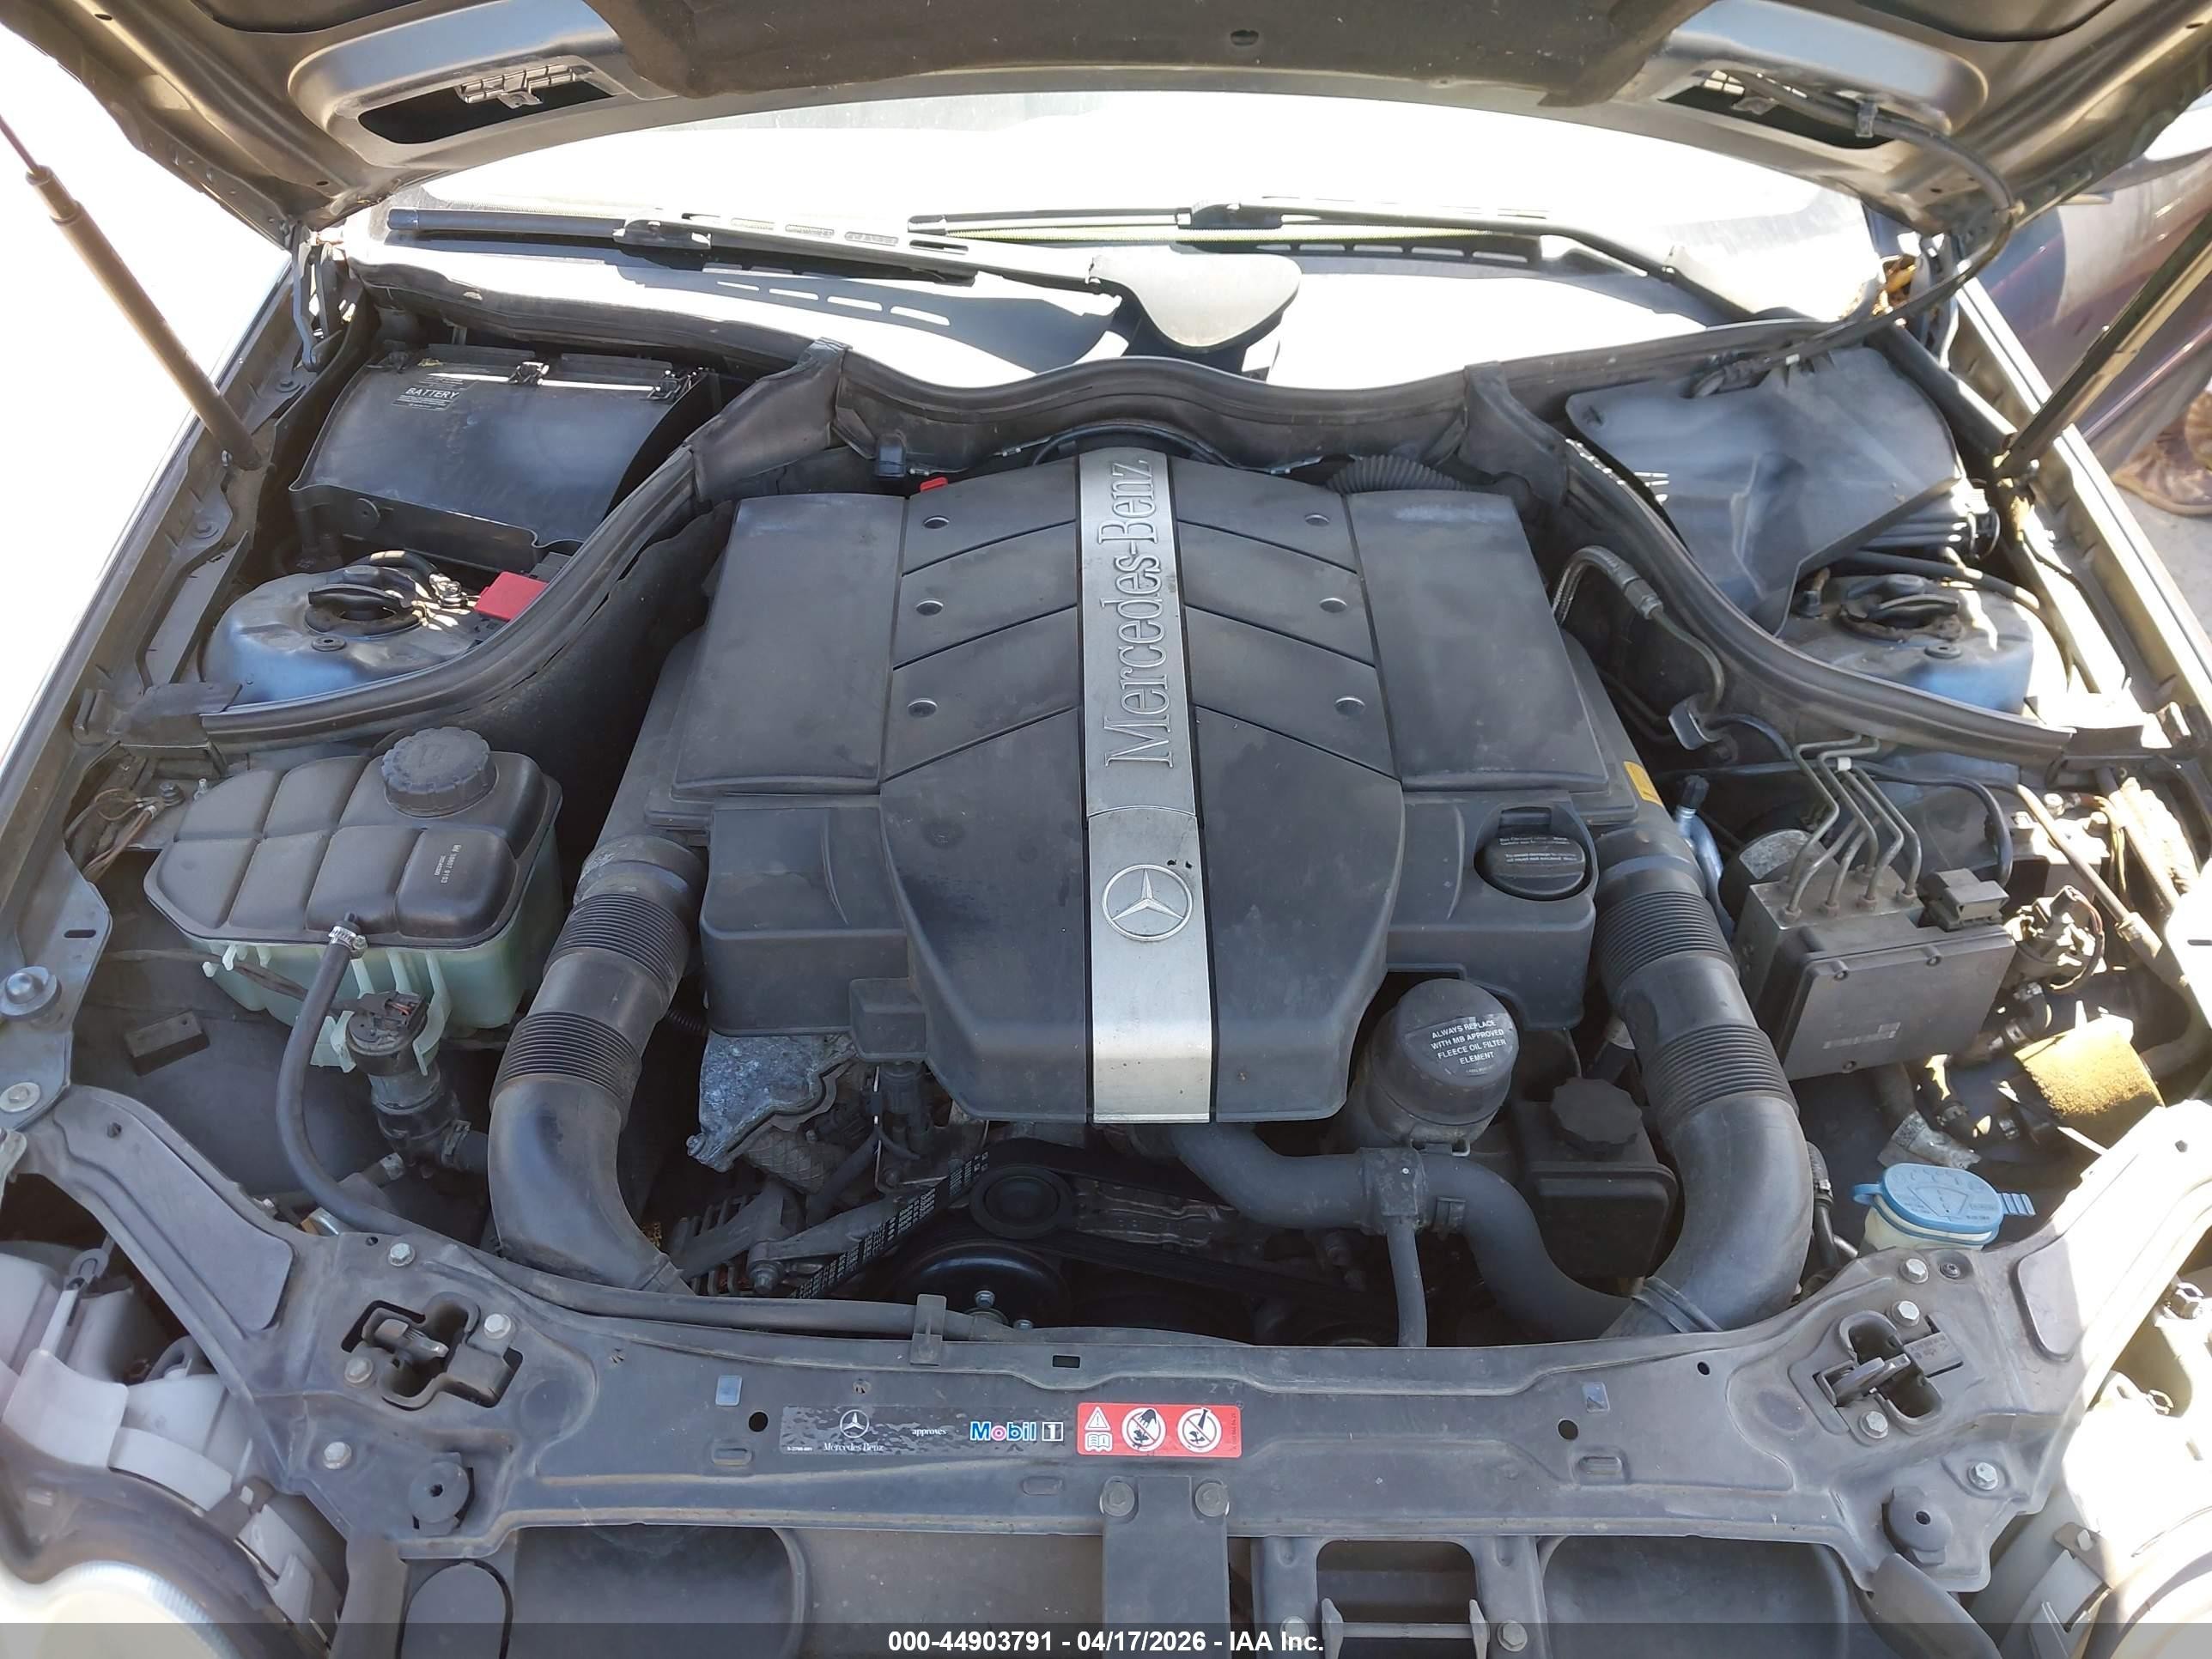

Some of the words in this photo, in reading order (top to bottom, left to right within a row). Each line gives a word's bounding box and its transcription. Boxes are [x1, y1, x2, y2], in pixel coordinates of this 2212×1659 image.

[405, 387, 460, 399] BATTERY
[1097, 459, 1174, 768] Mercedes-Benz
[1431, 1025, 1463, 1039] ALWAYS
[1463, 1019, 1497, 1031] REPLACE
[1431, 1038, 1453, 1050] WITH
[1452, 1036, 1466, 1045] MB
[1467, 1029, 1504, 1041] APPROVED
[1437, 1045, 1468, 1059] FLEECE
[1469, 1042, 1483, 1052] OIL
[1483, 1038, 1507, 1048] FILTER
[1459, 1051, 1495, 1065] ELEMENT
[911, 1428, 948, 1437] approves
[969, 1421, 1037, 1442] Mobil
